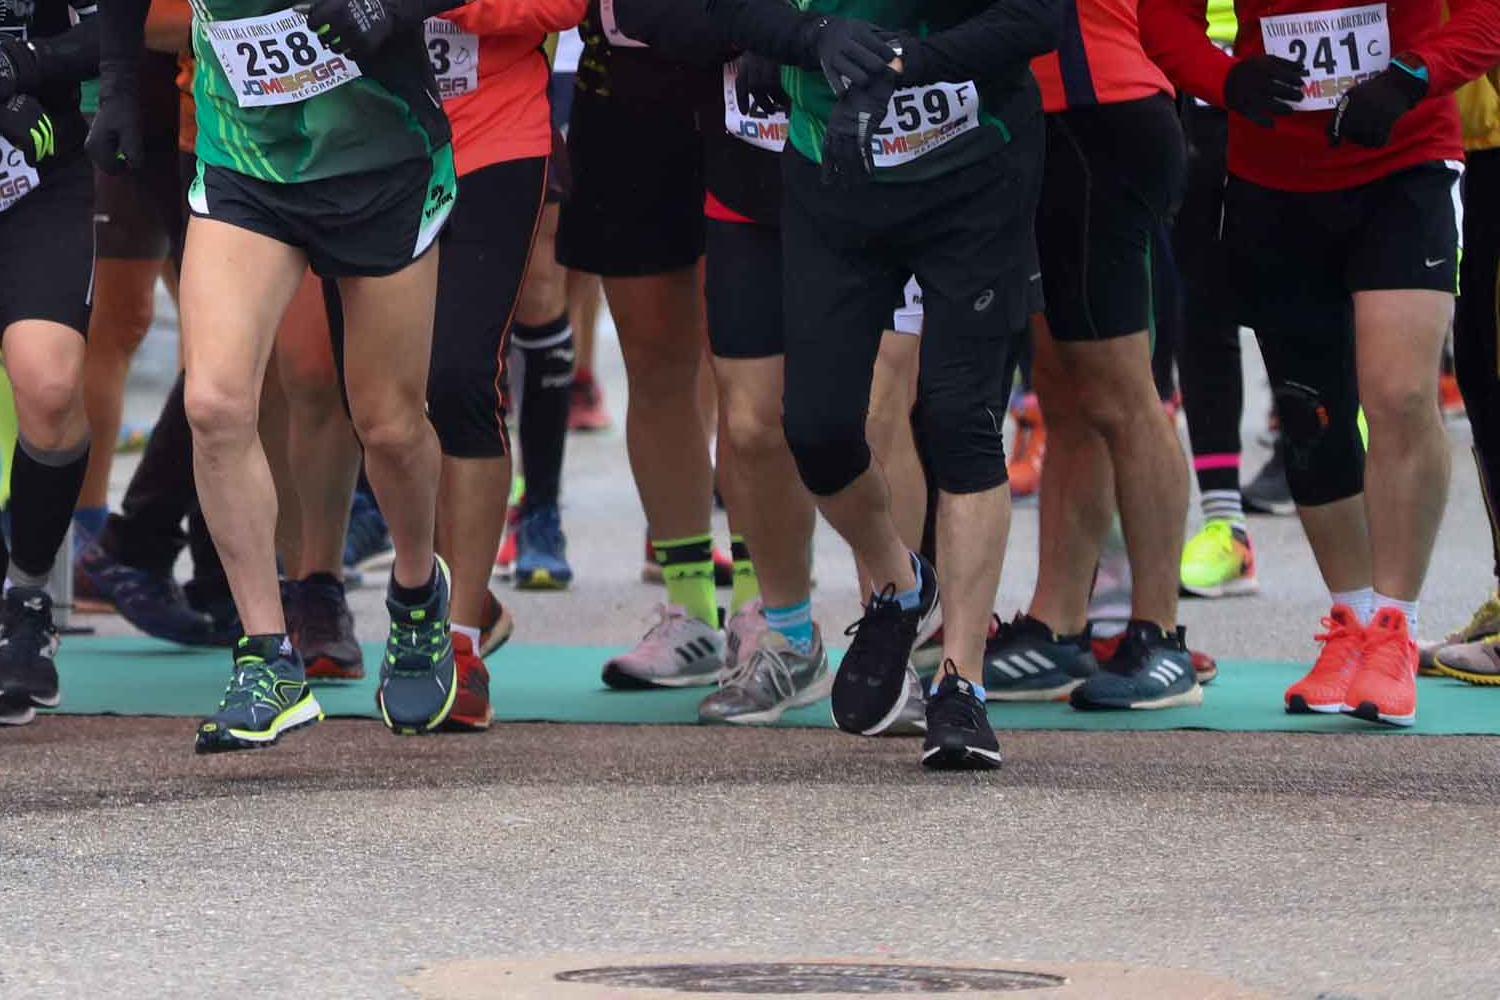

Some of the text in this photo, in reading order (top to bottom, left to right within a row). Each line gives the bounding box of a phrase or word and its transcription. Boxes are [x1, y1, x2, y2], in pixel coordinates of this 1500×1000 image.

[230, 26, 249, 40] LIGA
[249, 23, 273, 38] CROSS
[1304, 19, 1330, 34] CROSS
[236, 31, 317, 76] 258
[1288, 31, 1361, 77] 241
[1367, 40, 1382, 56] C
[242, 57, 348, 95] JOMISAGA
[292, 72, 349, 100] REFORMAS
[955, 85, 969, 107] F
[875, 89, 950, 135] 59
[7, 149, 21, 167] C
